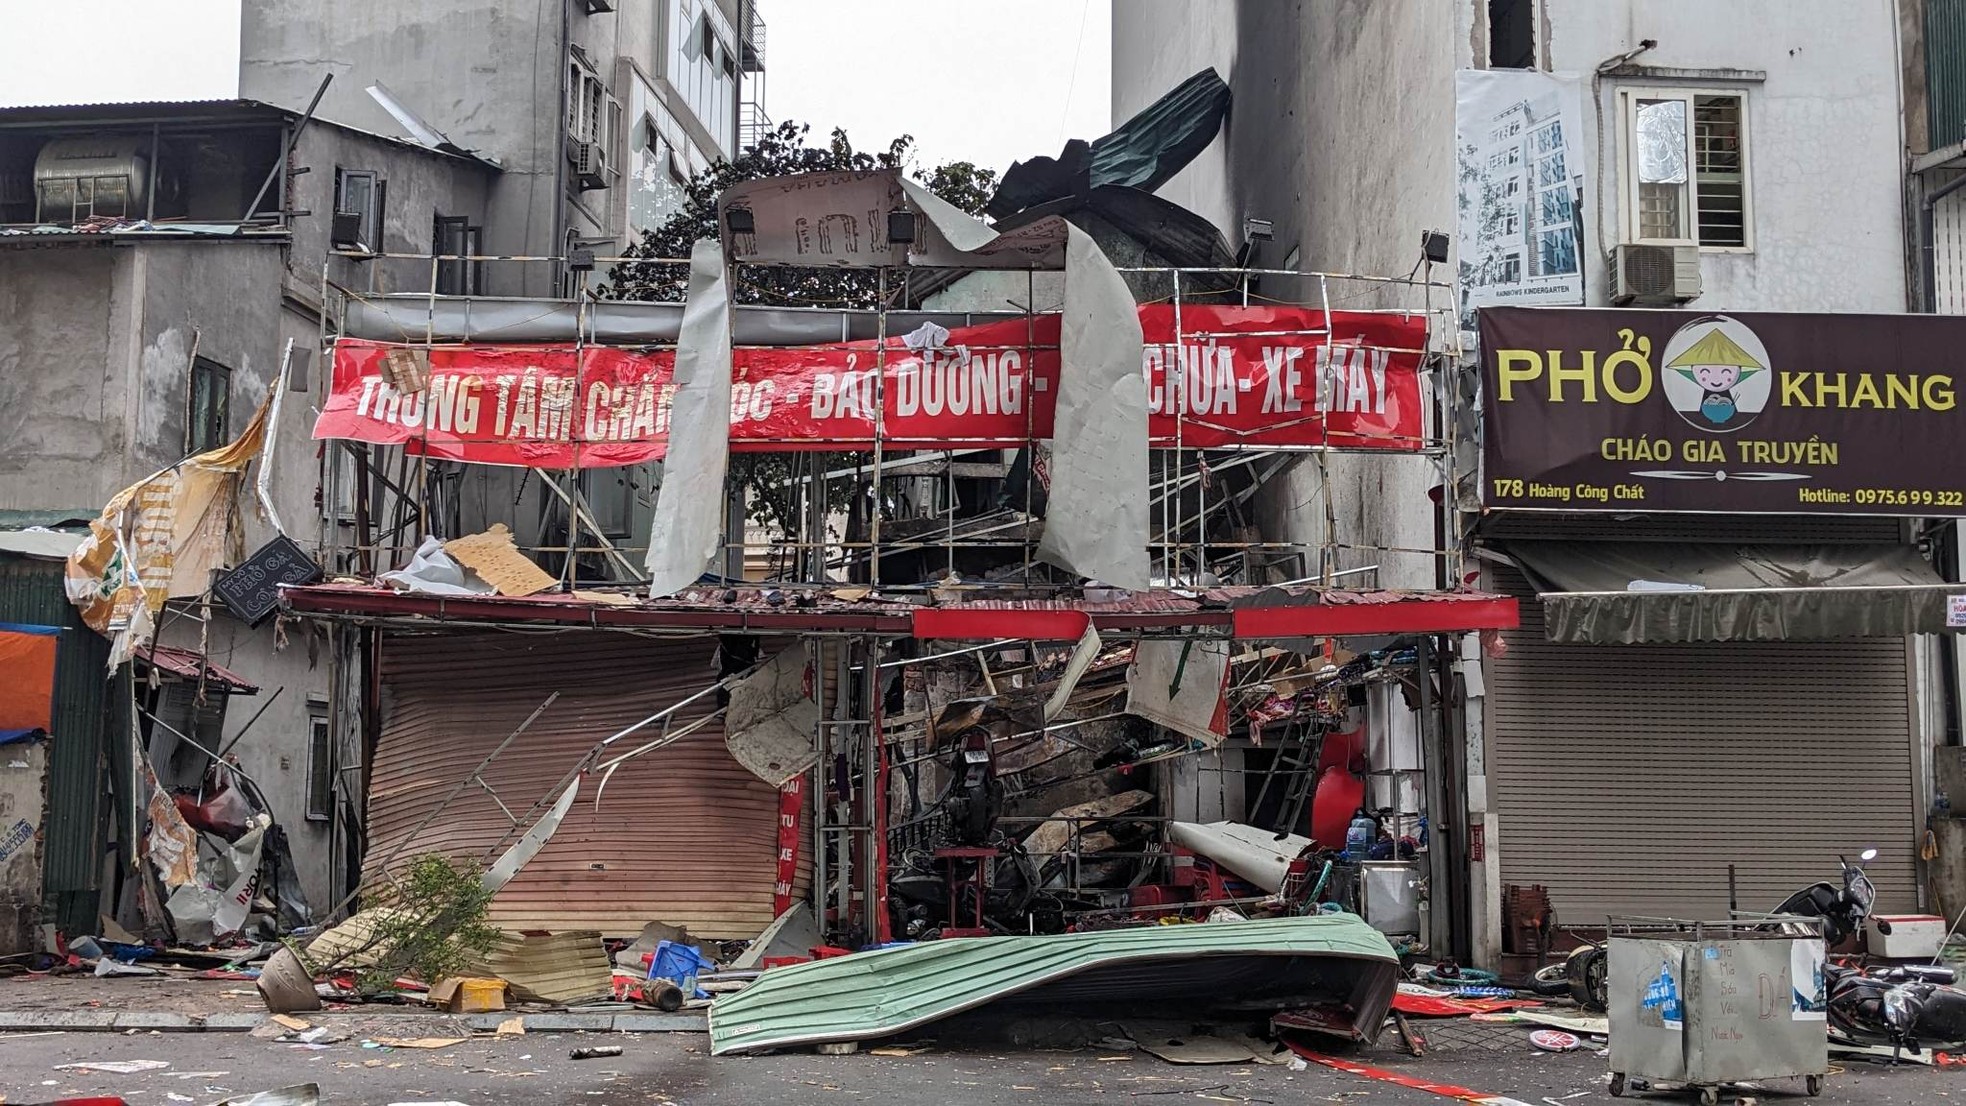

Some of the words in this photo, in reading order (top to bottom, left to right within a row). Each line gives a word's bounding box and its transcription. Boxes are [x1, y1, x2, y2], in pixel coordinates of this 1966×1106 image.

[1495, 288, 1523, 298] RAINBOWS
[1524, 285, 1570, 296] KINDERGARTEN
[1261, 346, 1304, 414] XE
[1314, 333, 1390, 414] MÁY
[1496, 328, 1653, 404] PHỞ
[1780, 371, 1957, 412] KHANG
[1601, 433, 1673, 463] CHÁO
[1682, 440, 1726, 464] GIA
[1737, 434, 1839, 466] TRUYỀN
[1493, 479, 1525, 498] 178
[1528, 483, 1571, 501] Hoàng
[1575, 484, 1609, 502] Công
[1613, 484, 1645, 499] Chất
[1798, 488, 1851, 503] Hotline:
[780, 847, 793, 862] XE
